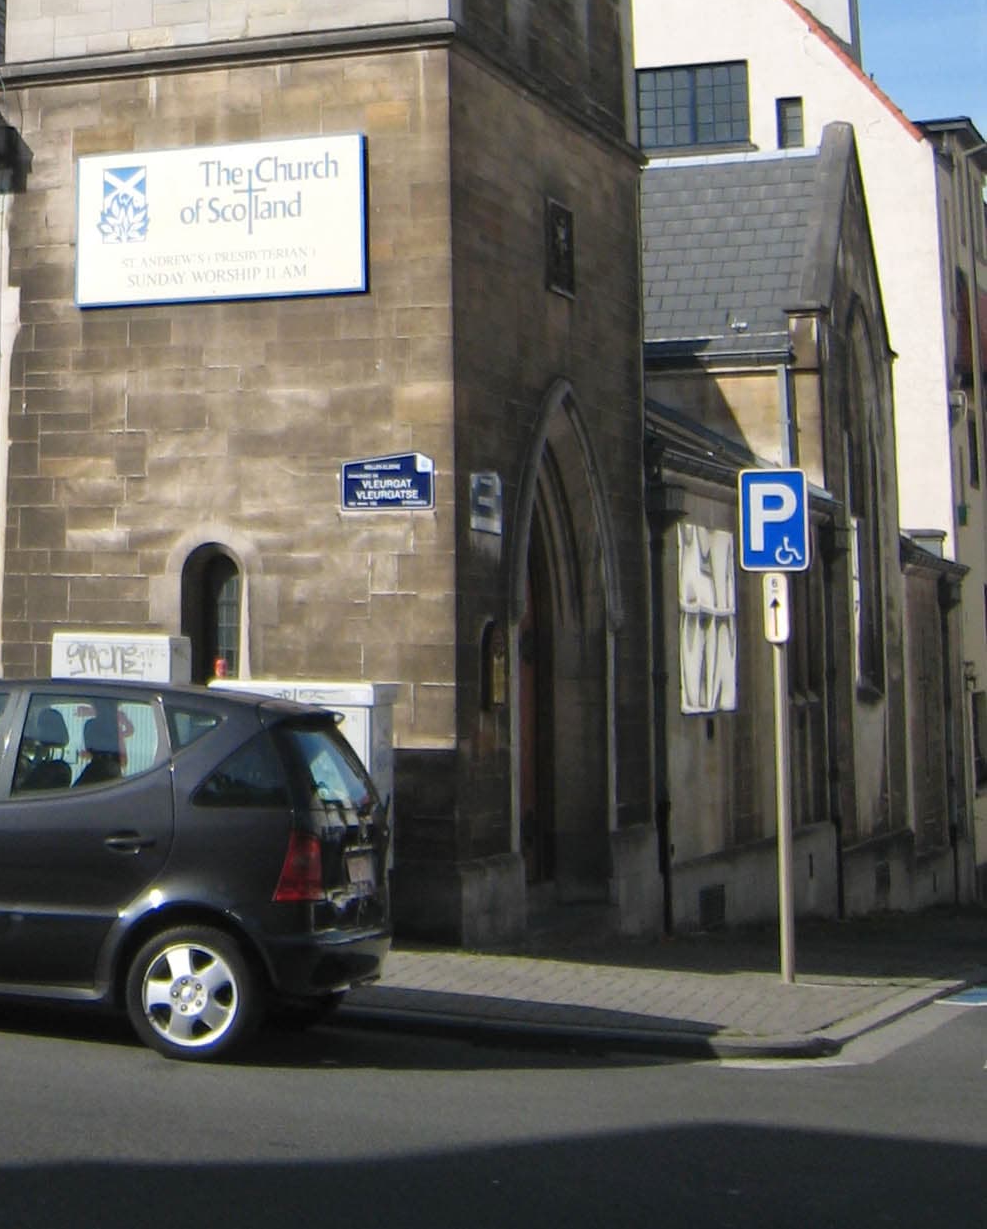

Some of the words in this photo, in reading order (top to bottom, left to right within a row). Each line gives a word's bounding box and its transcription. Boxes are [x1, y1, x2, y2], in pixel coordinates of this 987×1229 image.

[199, 161, 243, 188] The
[255, 151, 339, 184] Church
[180, 197, 202, 225] of
[127, 271, 187, 288] SUNDAY
[192, 267, 262, 284] WORSHIP
[282, 263, 308, 279] AM
[355, 489, 419, 500] VLEURGATSE
[361, 479, 413, 489] VLEURGAT
[749, 484, 797, 551] P
